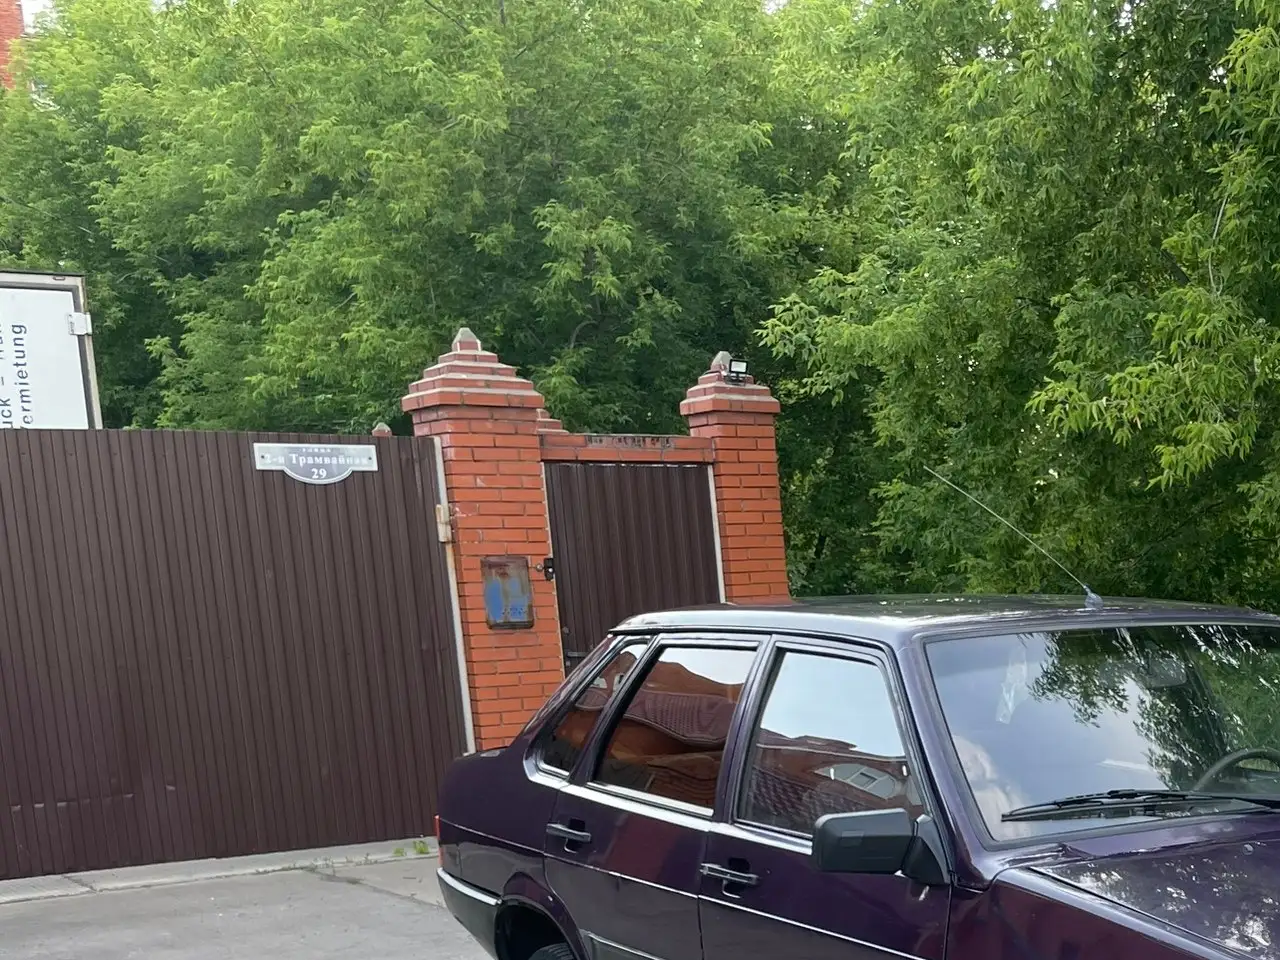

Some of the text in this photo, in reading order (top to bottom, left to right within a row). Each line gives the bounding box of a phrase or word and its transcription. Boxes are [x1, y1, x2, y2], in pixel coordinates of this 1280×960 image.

[11, 324, 33, 429] ermietung
[289, 453, 368, 468] Трамвайная
[311, 468, 327, 479] 29
